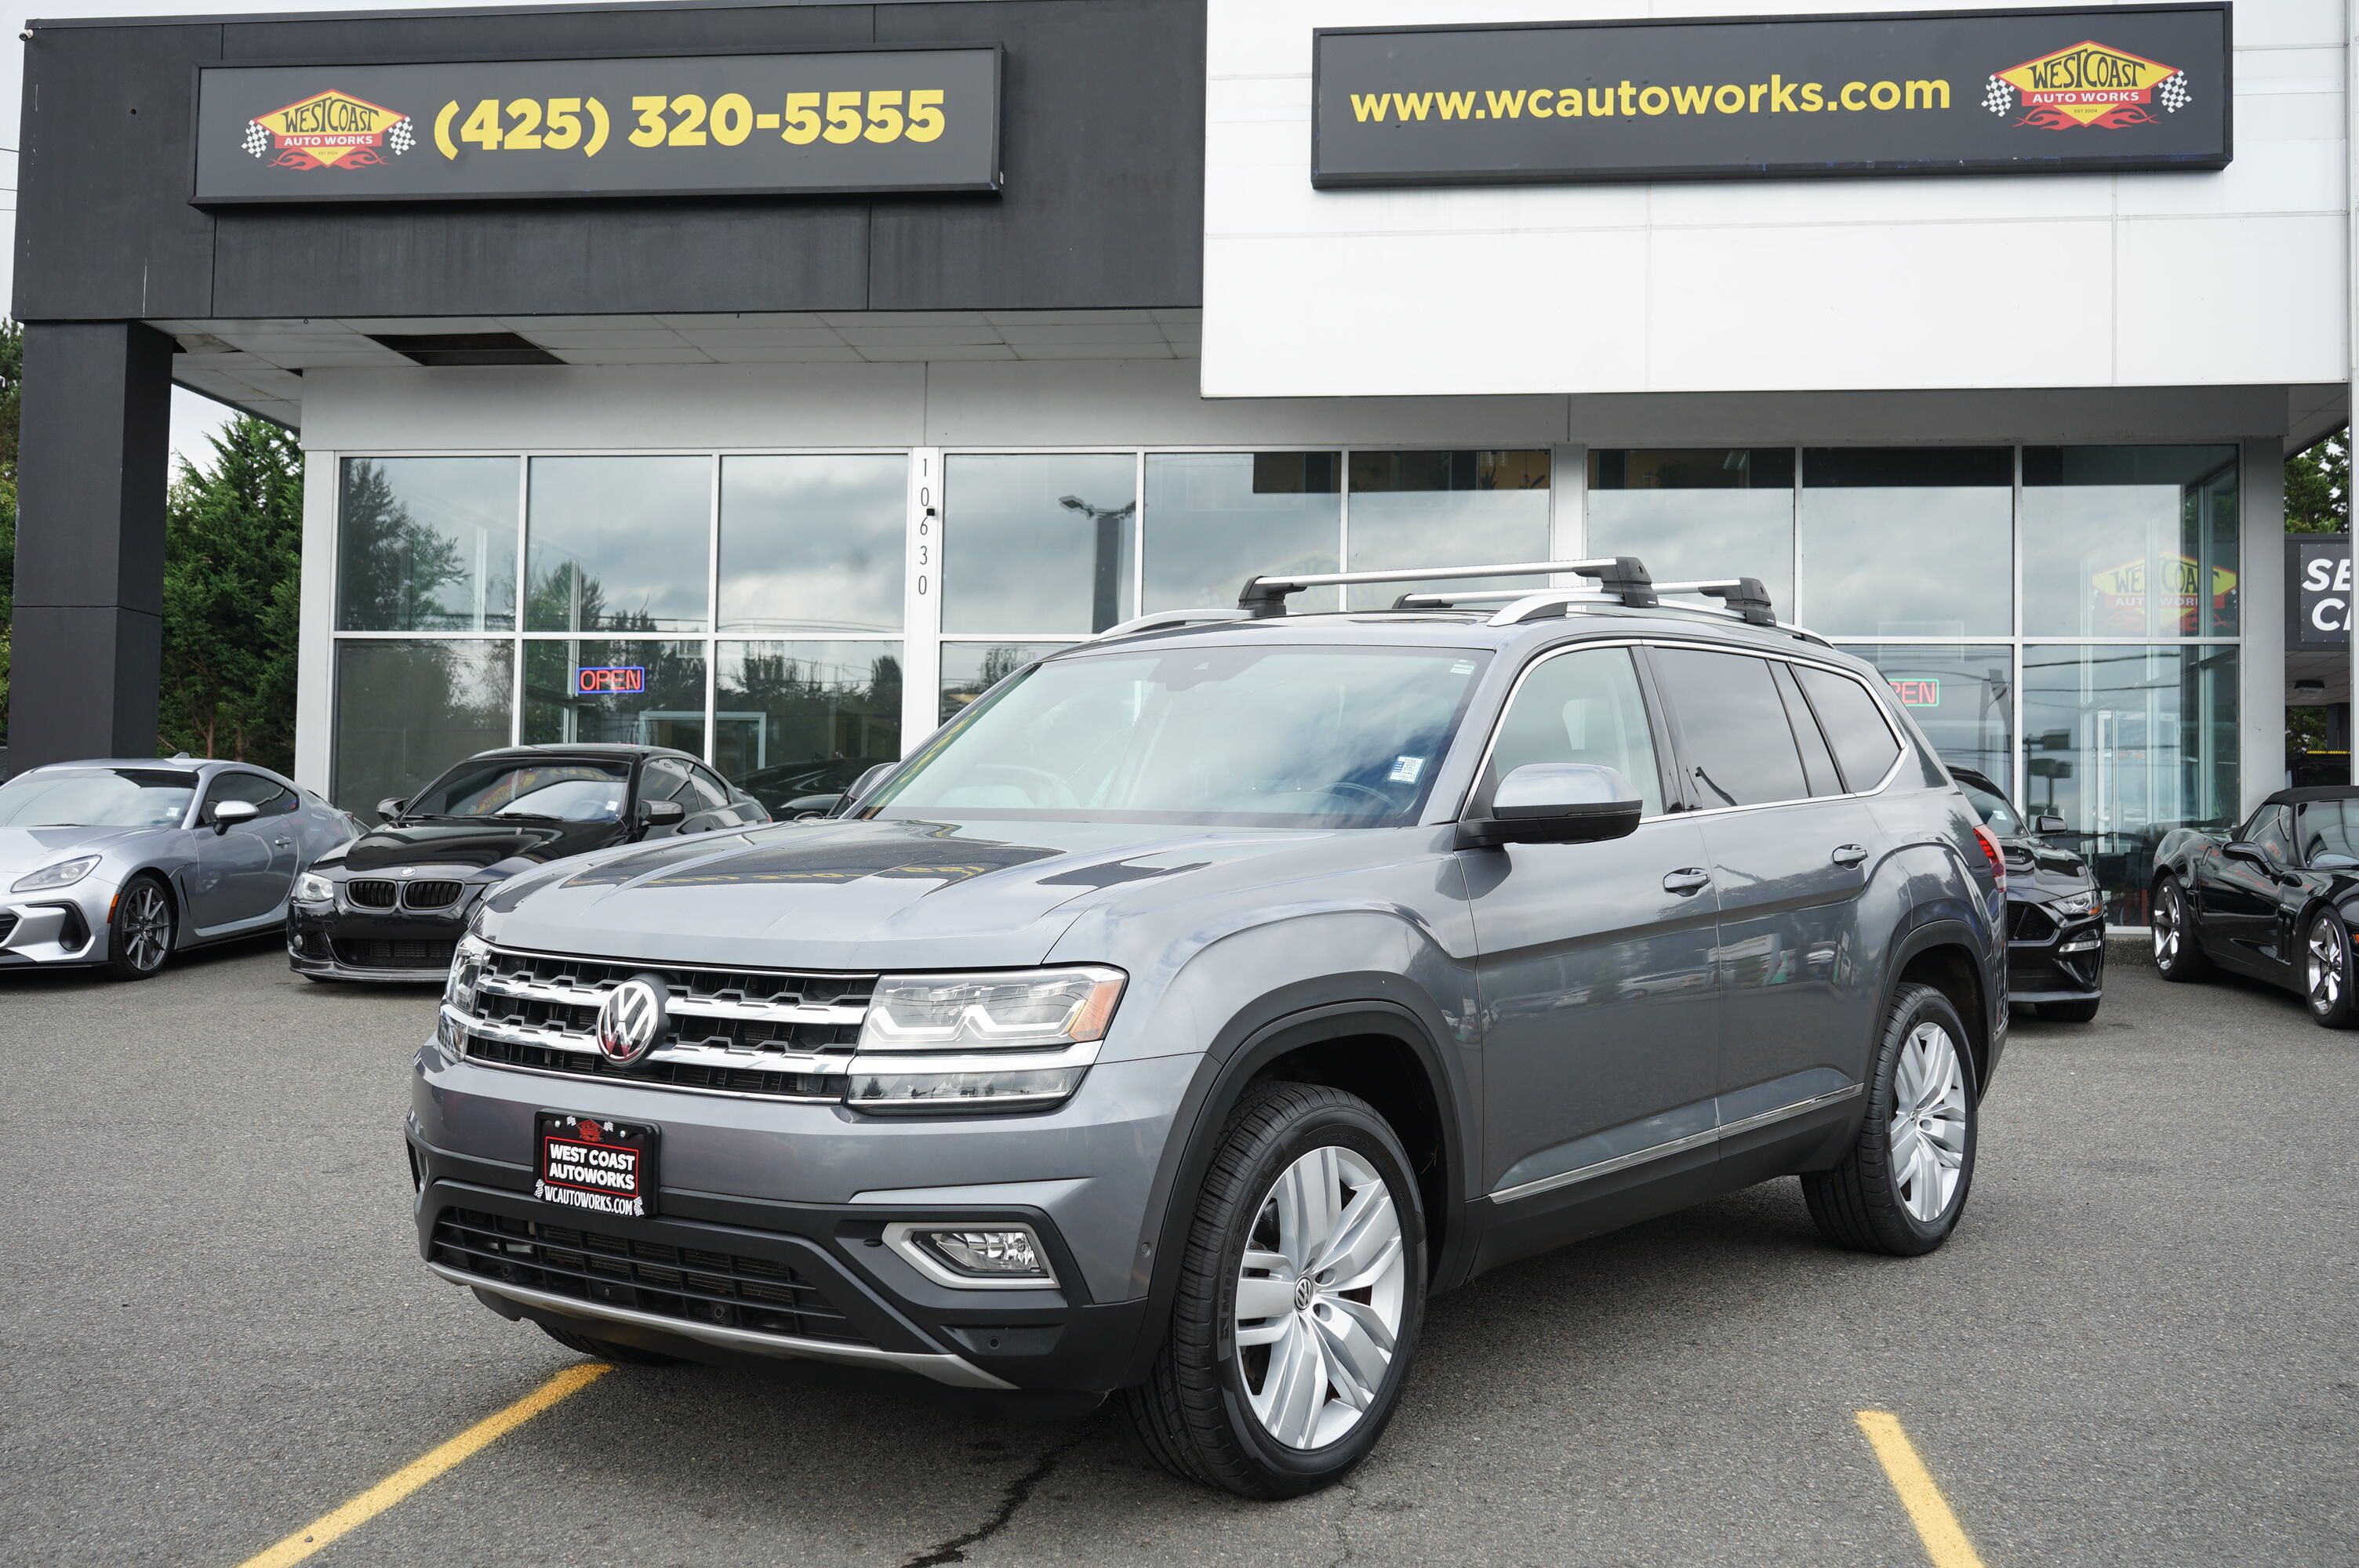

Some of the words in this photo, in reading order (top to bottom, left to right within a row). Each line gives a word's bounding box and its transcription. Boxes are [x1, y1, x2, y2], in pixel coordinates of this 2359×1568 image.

[1350, 74, 1950, 122] www.wcautoworks.com
[2032, 93, 2077, 103] AUTO
[2081, 92, 2139, 102] WORKS
[434, 96, 610, 161] (425)
[627, 89, 945, 149] 320-5555
[284, 136, 321, 147] AUTO
[325, 136, 373, 146] WORKS
[918, 459, 929, 595] 10630
[2115, 597, 2145, 607] AUT
[580, 670, 642, 691] OPEN
[1890, 681, 1936, 703] PEN
[550, 1143, 587, 1163] WEST
[589, 1149, 635, 1171] COAST
[549, 1163, 635, 1190] AUTOWORKS
[543, 1185, 633, 1216] WCAUTOWORKS.COM
